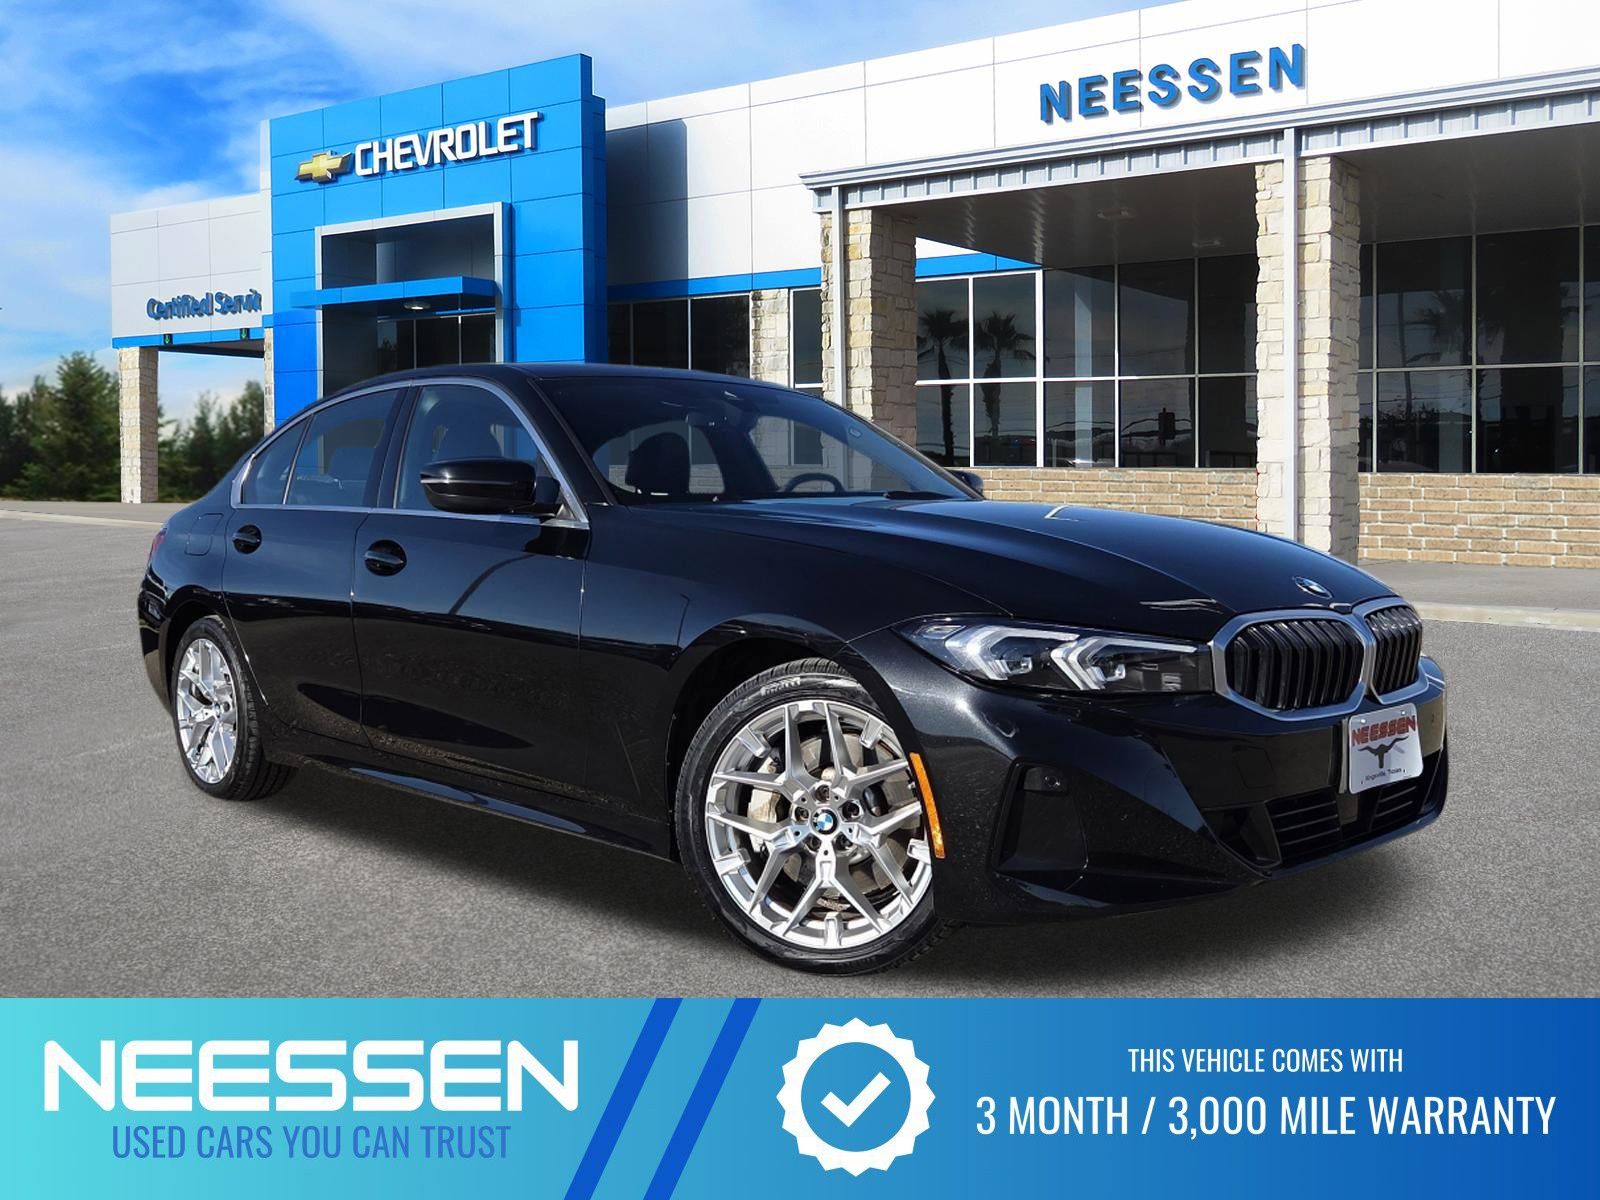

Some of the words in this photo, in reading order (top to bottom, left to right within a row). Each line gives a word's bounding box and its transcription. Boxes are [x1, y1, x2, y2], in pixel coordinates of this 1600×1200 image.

[1039, 43, 1306, 123] NEESSEN
[354, 111, 541, 177] CHEVROLET
[147, 292, 213, 320] Certified
